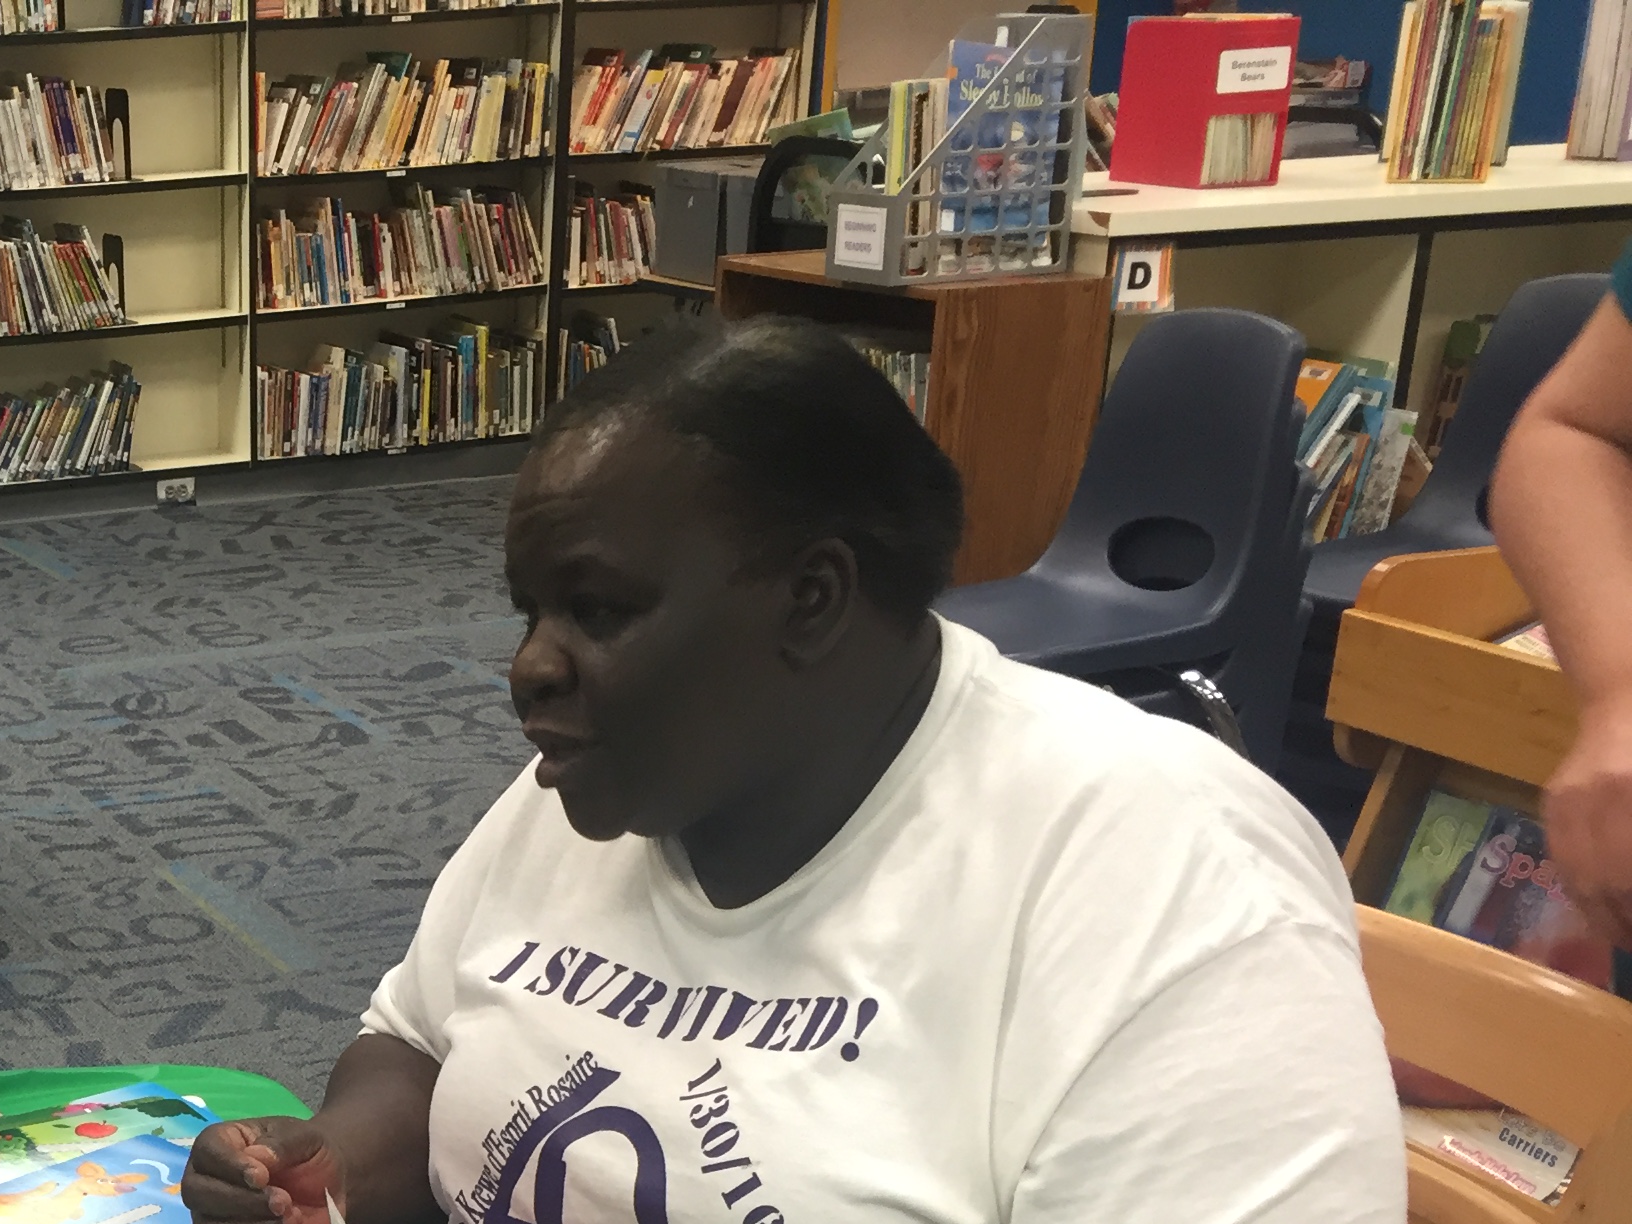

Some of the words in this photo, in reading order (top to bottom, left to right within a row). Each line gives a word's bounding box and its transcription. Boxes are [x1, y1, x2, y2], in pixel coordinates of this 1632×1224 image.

[1127, 261, 1152, 290] D
[489, 941, 540, 983] I
[523, 945, 879, 1062] SURVIVED!
[1498, 1127, 1559, 1168] Carriers
